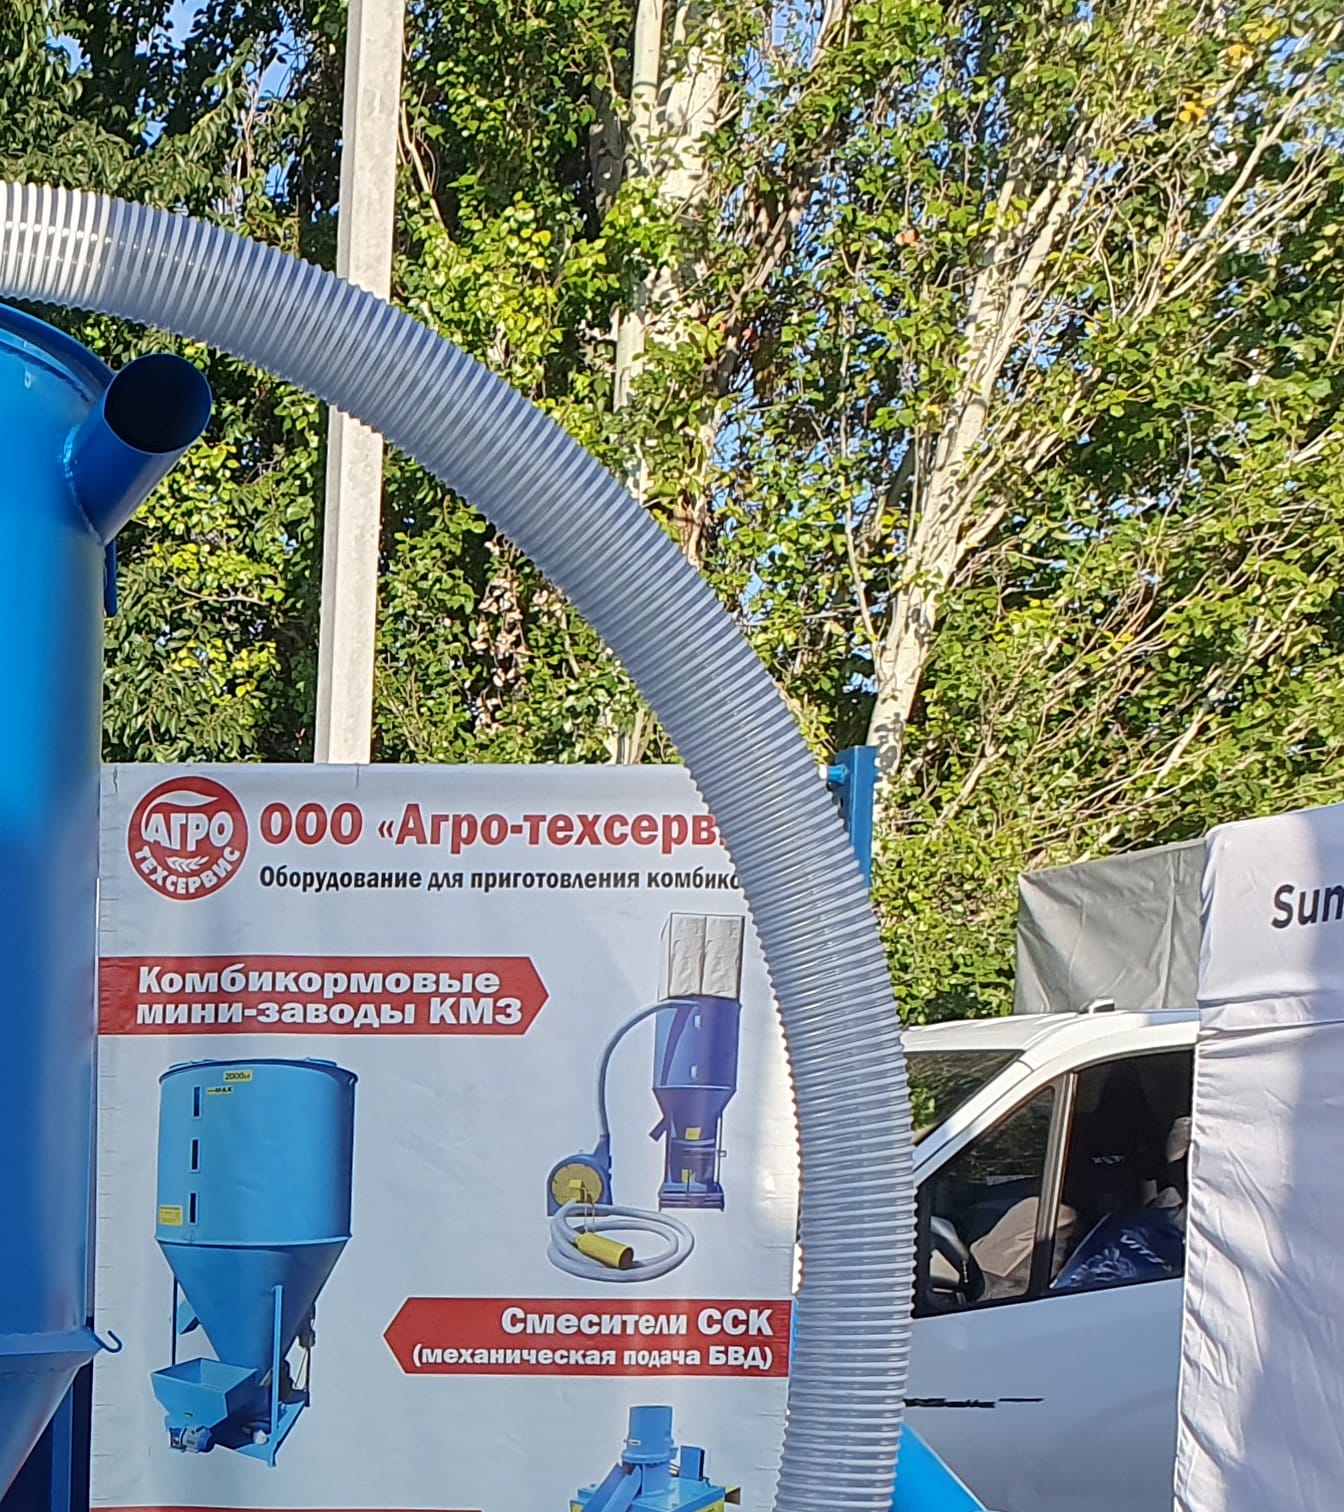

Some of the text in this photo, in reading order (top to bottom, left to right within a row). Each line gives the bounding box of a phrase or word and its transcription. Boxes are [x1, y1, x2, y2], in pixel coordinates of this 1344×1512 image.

[142, 810, 234, 851] АГРО
[260, 802, 725, 854] ООО «Агро-техсерв
[134, 845, 241, 894] ТЕХСЕРВИС
[260, 866, 422, 892] Оборудование
[427, 872, 463, 891] для
[470, 872, 640, 892] приготовления
[138, 963, 500, 999] Комбикормовые
[136, 997, 522, 1028] мини-заводы КМЗ
[501, 1307, 773, 1336] Смесители ССК
[413, 1343, 773, 1370] (механическая подача БВД)
